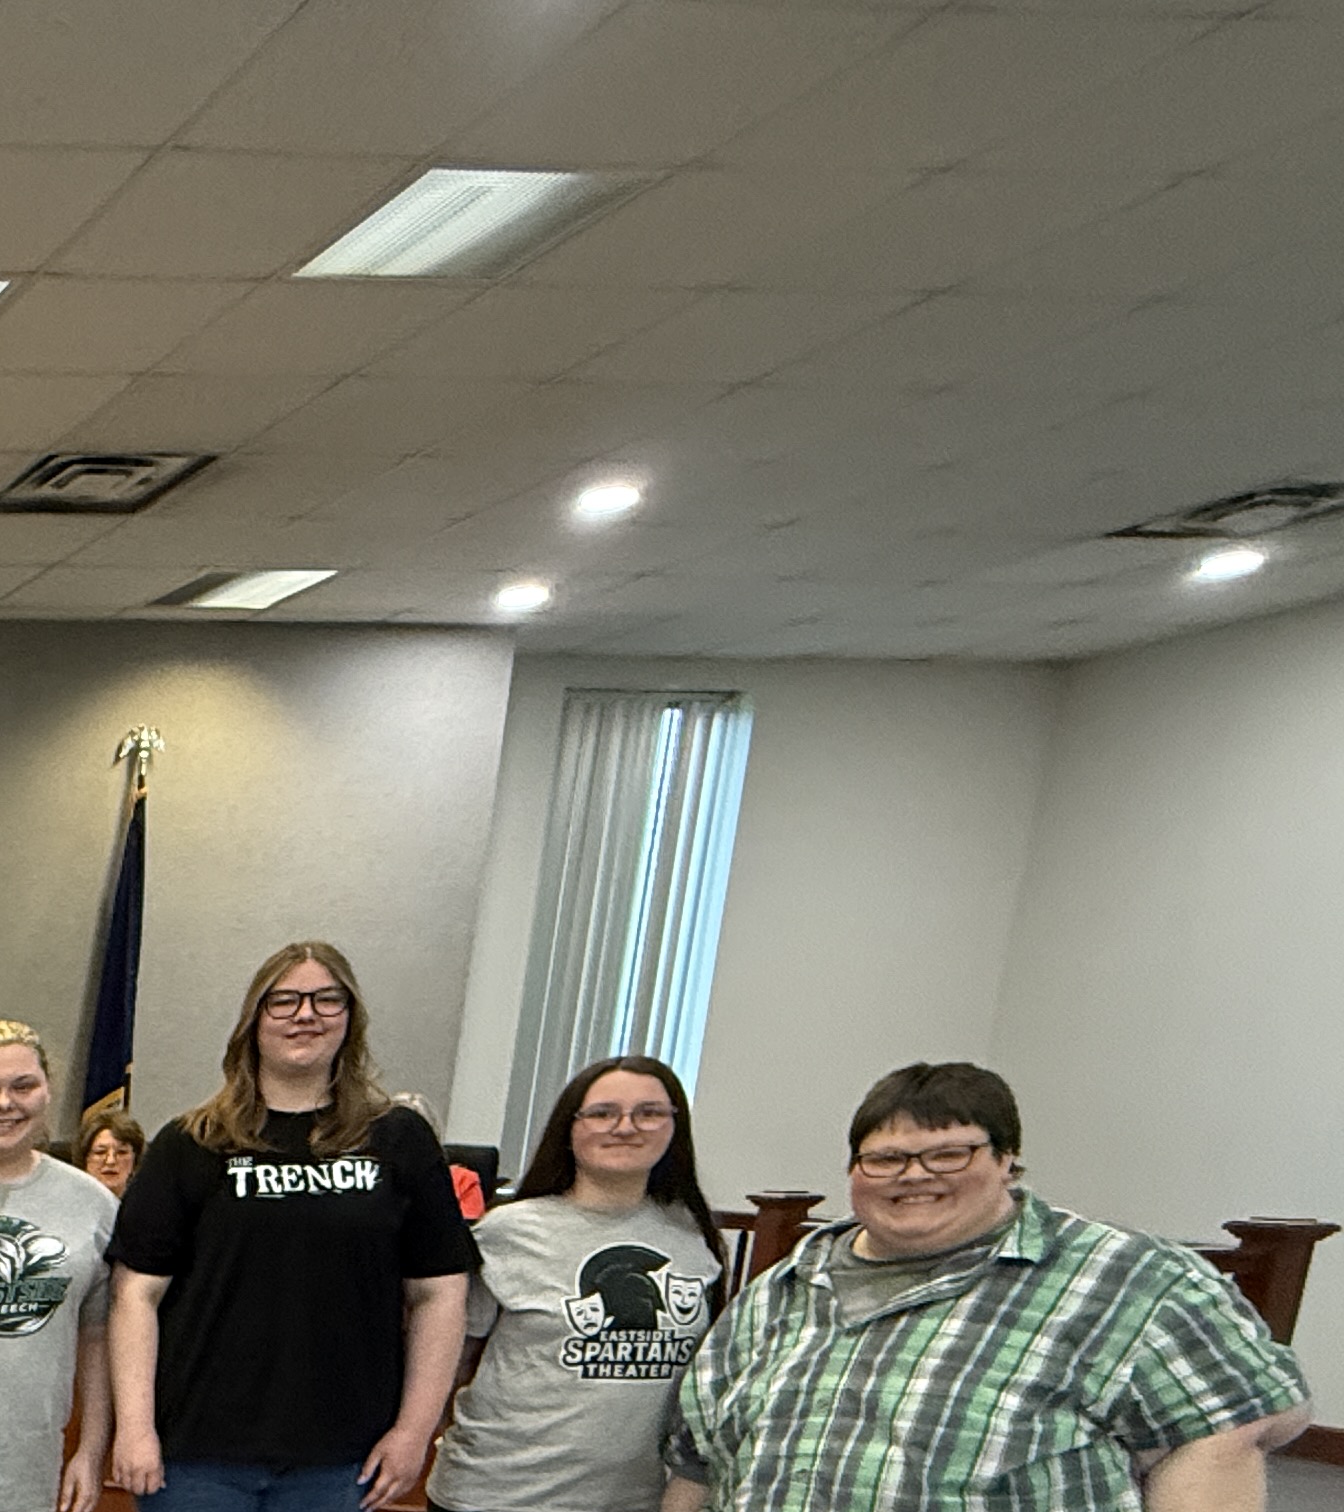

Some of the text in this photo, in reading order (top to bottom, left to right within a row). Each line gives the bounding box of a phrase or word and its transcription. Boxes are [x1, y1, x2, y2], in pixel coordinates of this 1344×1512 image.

[225, 1156, 253, 1167] THE
[227, 1159, 380, 1198] TRENCH
[599, 1329, 673, 1342] EASTSIDE
[564, 1339, 693, 1364] SPARTANS
[585, 1363, 672, 1378] THEATER
